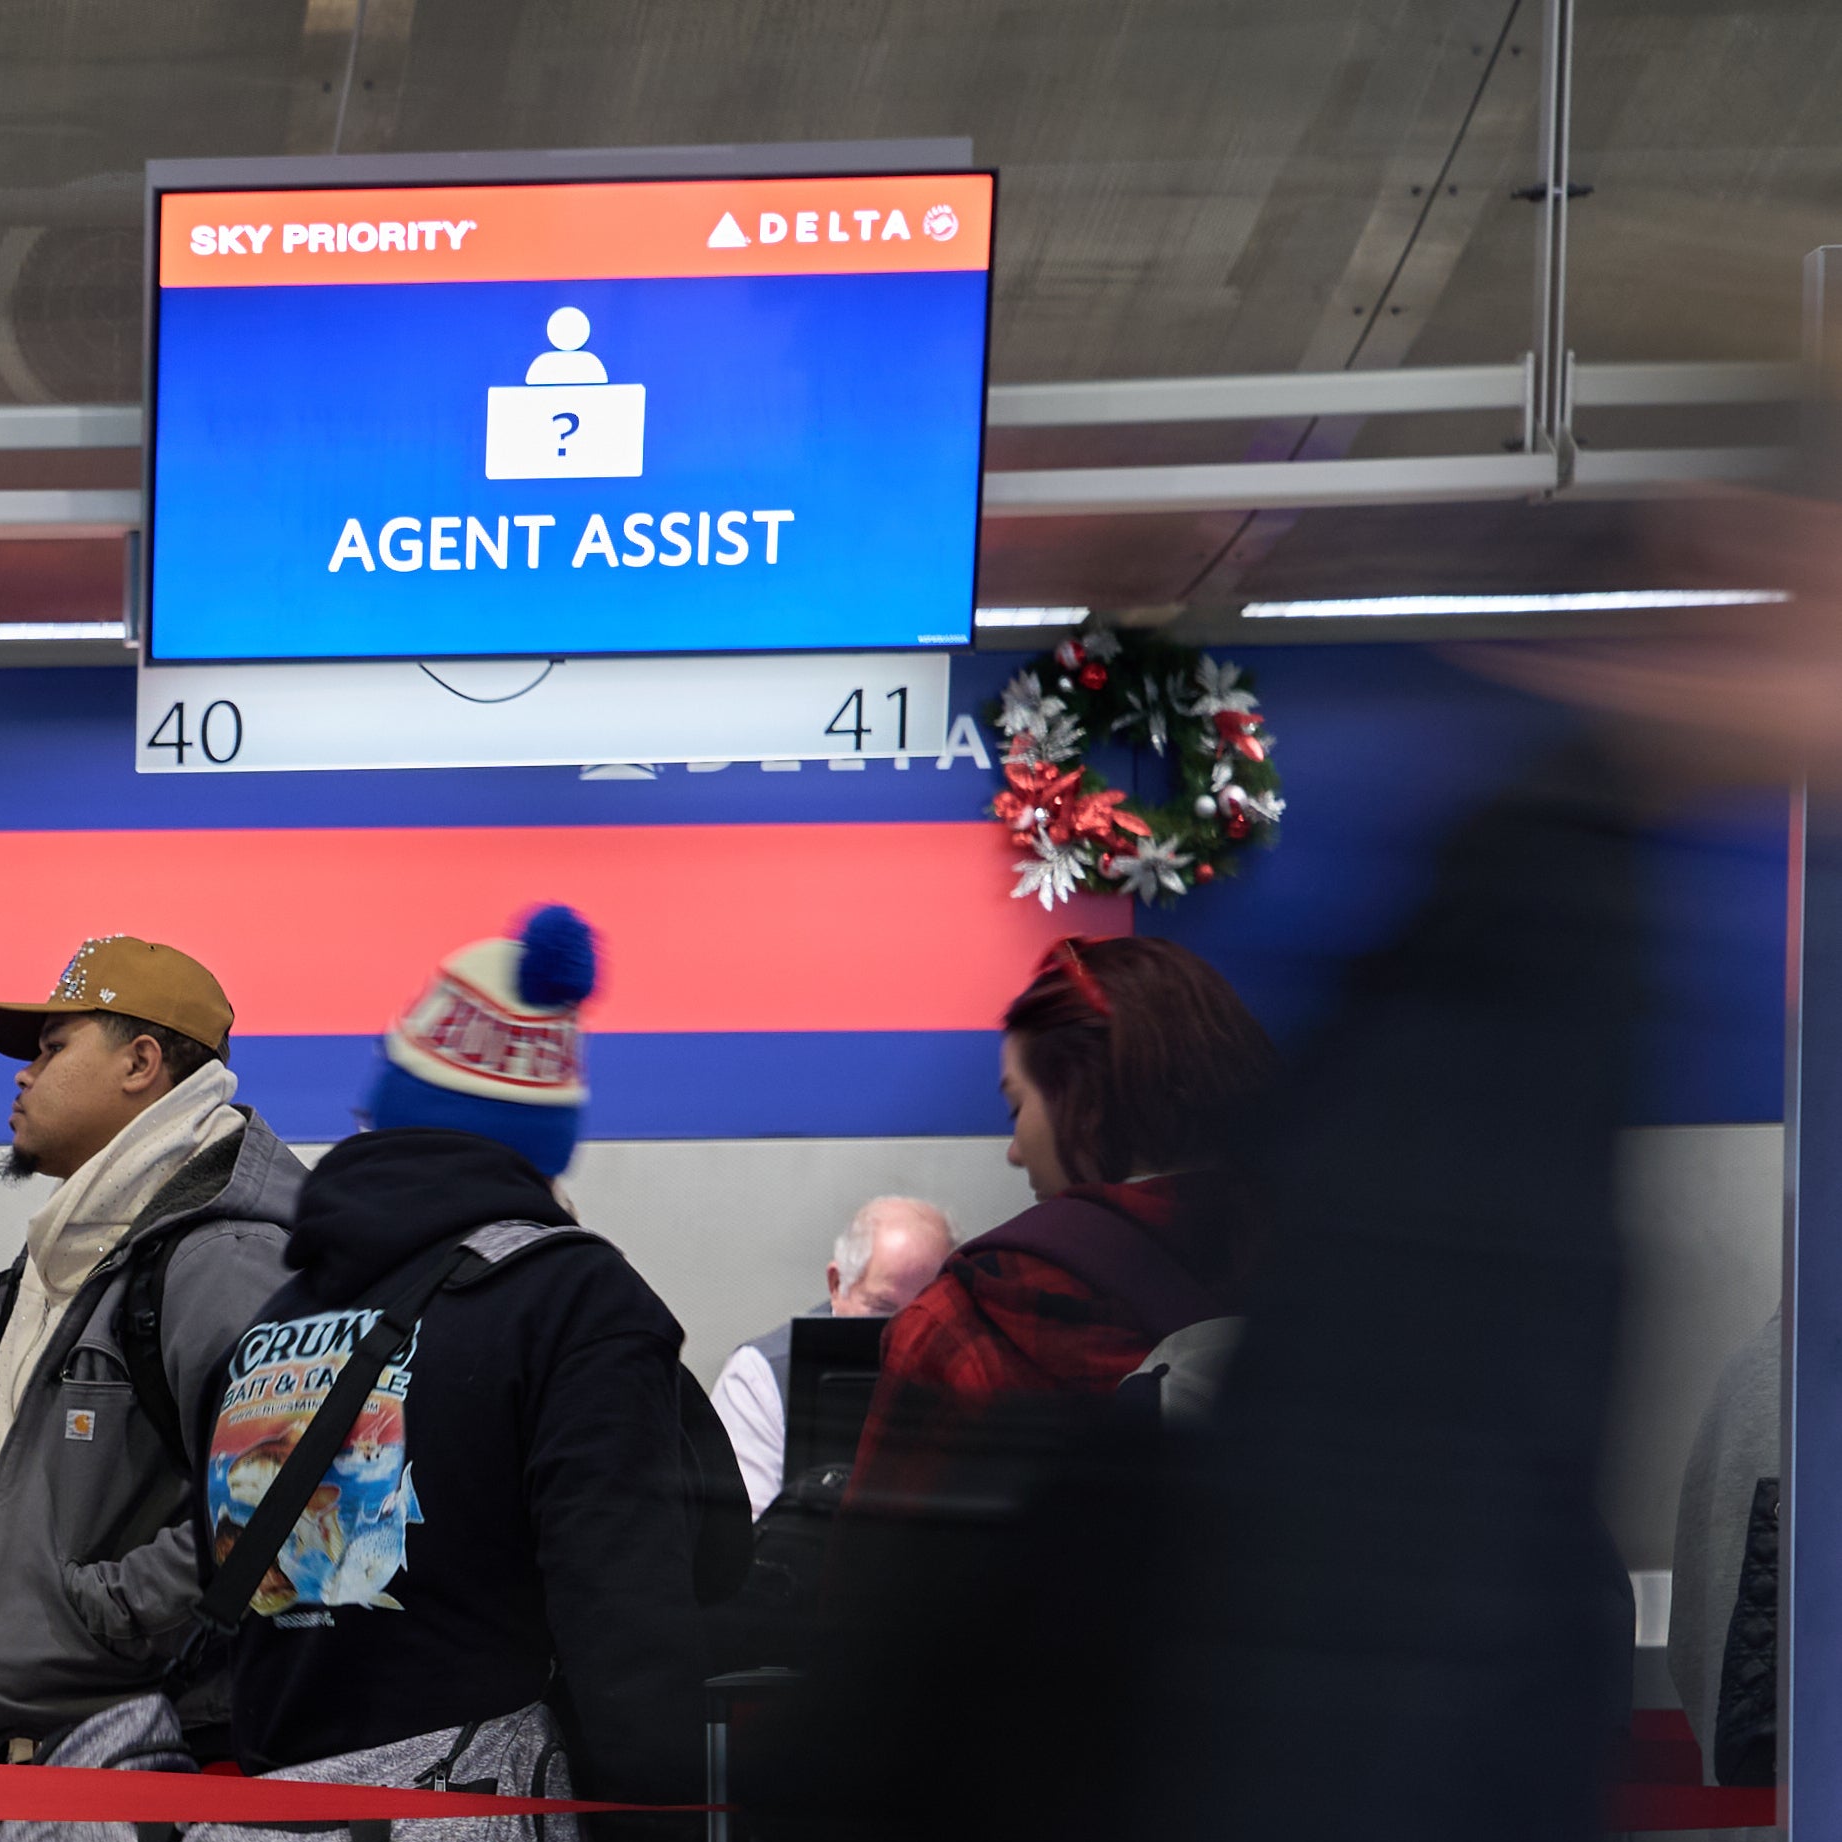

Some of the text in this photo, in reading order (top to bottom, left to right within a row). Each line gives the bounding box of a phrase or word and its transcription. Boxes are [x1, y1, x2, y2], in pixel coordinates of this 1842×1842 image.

[190, 219, 472, 255] SKY PRIORITY
[759, 209, 911, 243] DELTA
[328, 509, 794, 572] AGENT ASSIST
[147, 700, 242, 764] 40
[825, 687, 908, 751] 41
[222, 1374, 273, 1411] BAIT
[275, 1370, 298, 1395] &
